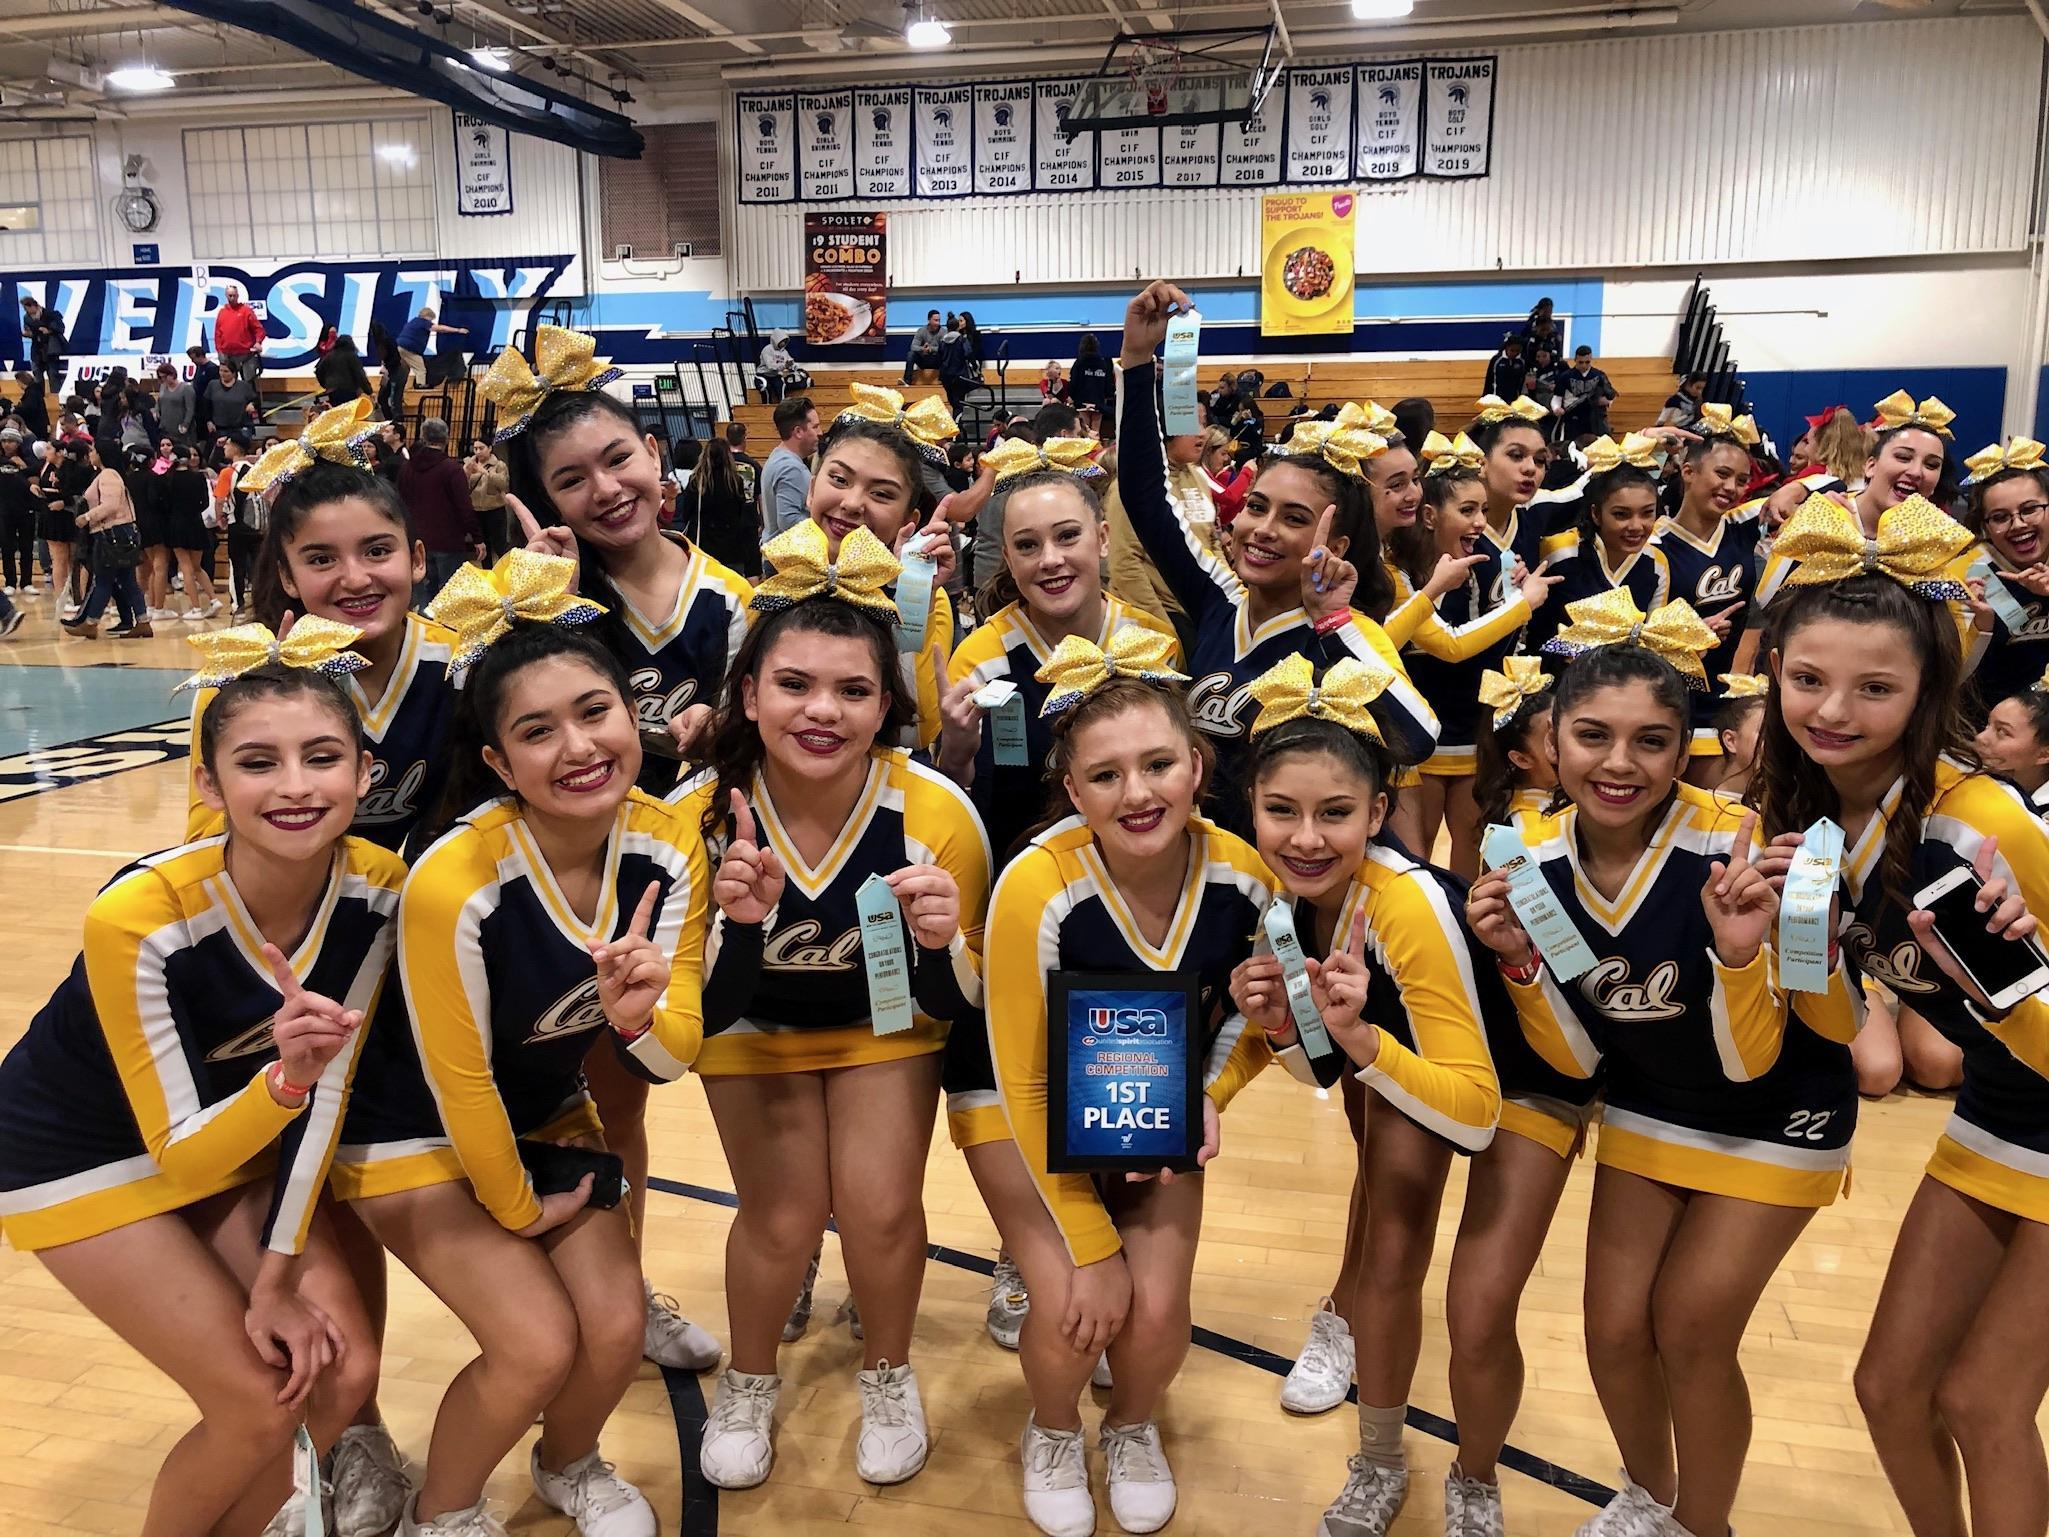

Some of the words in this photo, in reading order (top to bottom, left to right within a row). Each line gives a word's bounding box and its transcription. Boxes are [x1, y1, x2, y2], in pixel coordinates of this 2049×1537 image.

[1360, 66, 1419, 82] TROJANS
[1430, 65, 1490, 79] TROJANS
[1293, 70, 1350, 86] TROJANS
[857, 92, 909, 106] TROJANS
[917, 90, 970, 104] TROJANS
[976, 86, 1031, 102] TROJANS
[741, 99, 792, 112] TROJANS
[800, 95, 851, 110] TROJANS
[1309, 115, 1331, 123] GIRLS
[1375, 119, 1400, 127] TENNIS
[1181, 128, 1197, 136] GOLF
[1378, 129, 1397, 139] CIF
[1446, 127, 1466, 136] CIF
[1180, 140, 1197, 149] CIF
[1243, 137, 1261, 147] CIF
[1311, 135, 1328, 144] CIF
[1055, 148, 1071, 157] CIF
[1120, 143, 1139, 153] CIF
[1363, 144, 1410, 155] CHAMPIONS
[1431, 144, 1481, 153] CHAMPIONS
[935, 154, 951, 163] CIF
[994, 152, 1010, 161] CIF
[1104, 154, 1156, 166] CHAMPIONS
[1165, 155, 1216, 165] CHAMPIONS
[1226, 154, 1275, 164] CHAMPIONS
[1291, 150, 1345, 160] CHAMPIONS
[760, 161, 775, 170] CIF
[819, 160, 835, 168] CIF
[875, 156, 890, 165] CIF
[1040, 160, 1088, 170] CHAMPIONS
[1437, 160, 1469, 170] 2019
[860, 168, 904, 177] CHAMPIONS
[920, 165, 968, 175] CHAMPIONS
[979, 164, 1026, 173] CHAMPIONS
[1302, 165, 1332, 176] 2018
[1371, 162, 1399, 173] 2019
[477, 173, 490, 182] CIF
[745, 173, 790, 182] CHAMPIONS
[804, 168, 849, 180] CHAMPIONS
[1050, 173, 1078, 184] 2014
[1116, 170, 1144, 182] 2015
[1176, 172, 1201, 182] 2017
[1235, 169, 1264, 180] 2018
[931, 180, 957, 190] 2013
[989, 176, 1017, 187] 2014
[465, 184, 504, 193] CHAMPIONS
[756, 187, 779, 198] 2011
[815, 184, 838, 195] 2011
[869, 182, 895, 193] 2012
[474, 198, 497, 208] 2010
[1265, 198, 1293, 206] PROUD
[1296, 197, 1307, 205] TO
[1265, 205, 1302, 213] SUPPORT
[1284, 212, 1324, 221] TROJANS!
[828, 235, 880, 246] STUDENT
[813, 248, 881, 263] COMBO
[1696, 565, 1743, 604] Cal
[1186, 672, 1252, 737] Cal
[762, 919, 862, 971] Cal
[1578, 955, 1686, 1022] Cal
[1096, 1052, 1158, 1064] REGIONAL
[1086, 1064, 1169, 1076] COMPETITION
[1106, 1082, 1151, 1103] 1ST
[1084, 1107, 1170, 1129] PLACE
